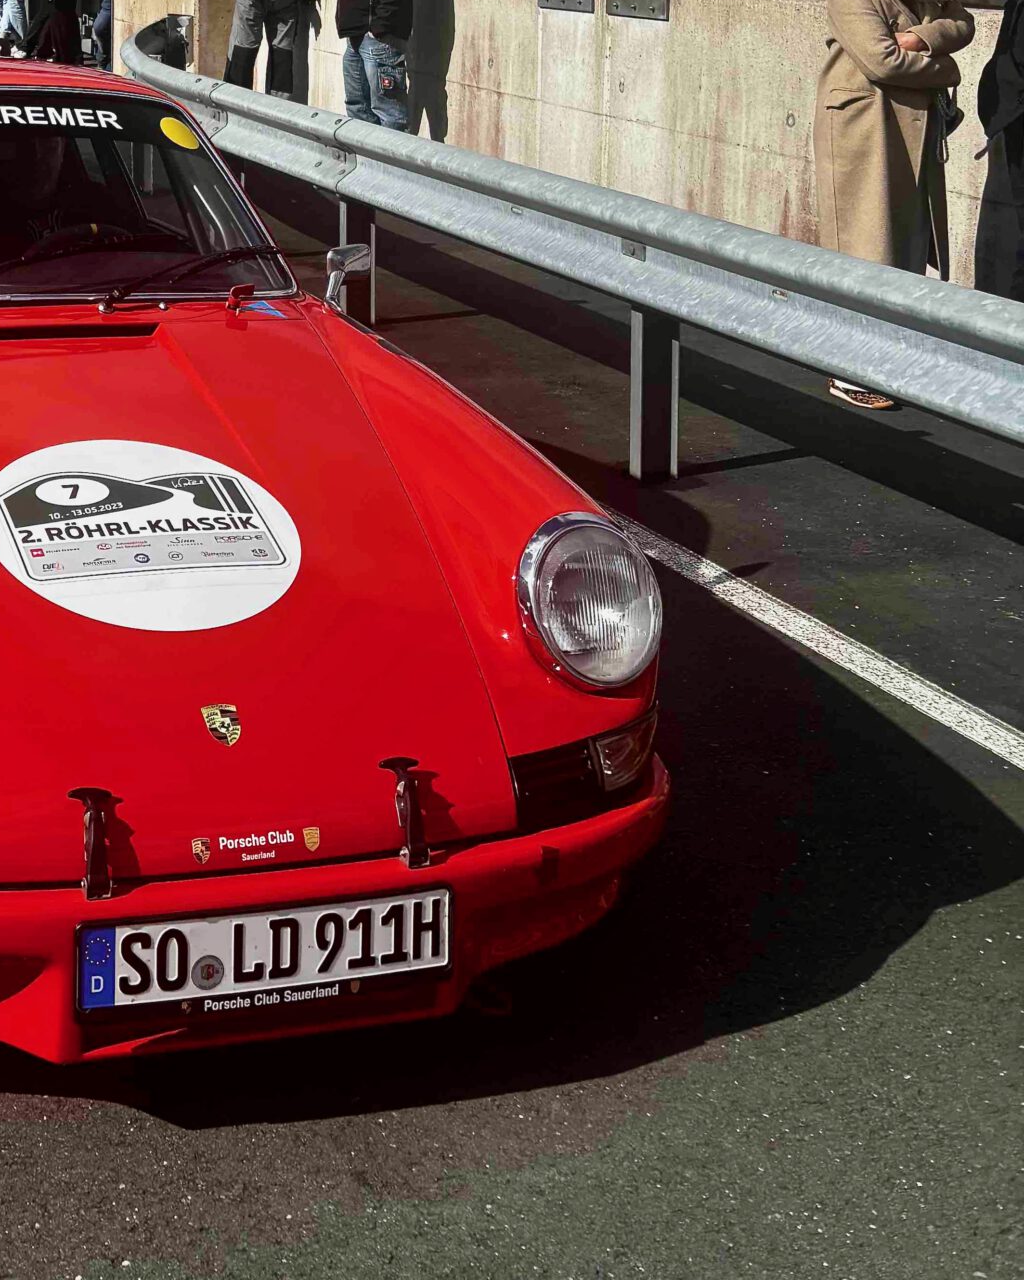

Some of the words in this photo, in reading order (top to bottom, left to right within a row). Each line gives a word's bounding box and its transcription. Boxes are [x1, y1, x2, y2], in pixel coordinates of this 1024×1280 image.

[61, 484, 80, 500] 7
[48, 512, 64, 521] 10.
[71, 502, 124, 517] 13.05.2023
[18, 529, 42, 544] 2.
[214, 534, 264, 542] PORSCHE
[219, 833, 266, 850] Porsche
[268, 829, 295, 845] Club
[241, 850, 276, 861] Sauerland
[91, 975, 104, 993] D
[118, 927, 189, 996] SO
[232, 917, 301, 984] LD
[315, 897, 441, 974] 911H
[204, 995, 251, 1012] Porsche
[254, 991, 281, 1006] Club
[283, 984, 339, 1003] Sauerland
